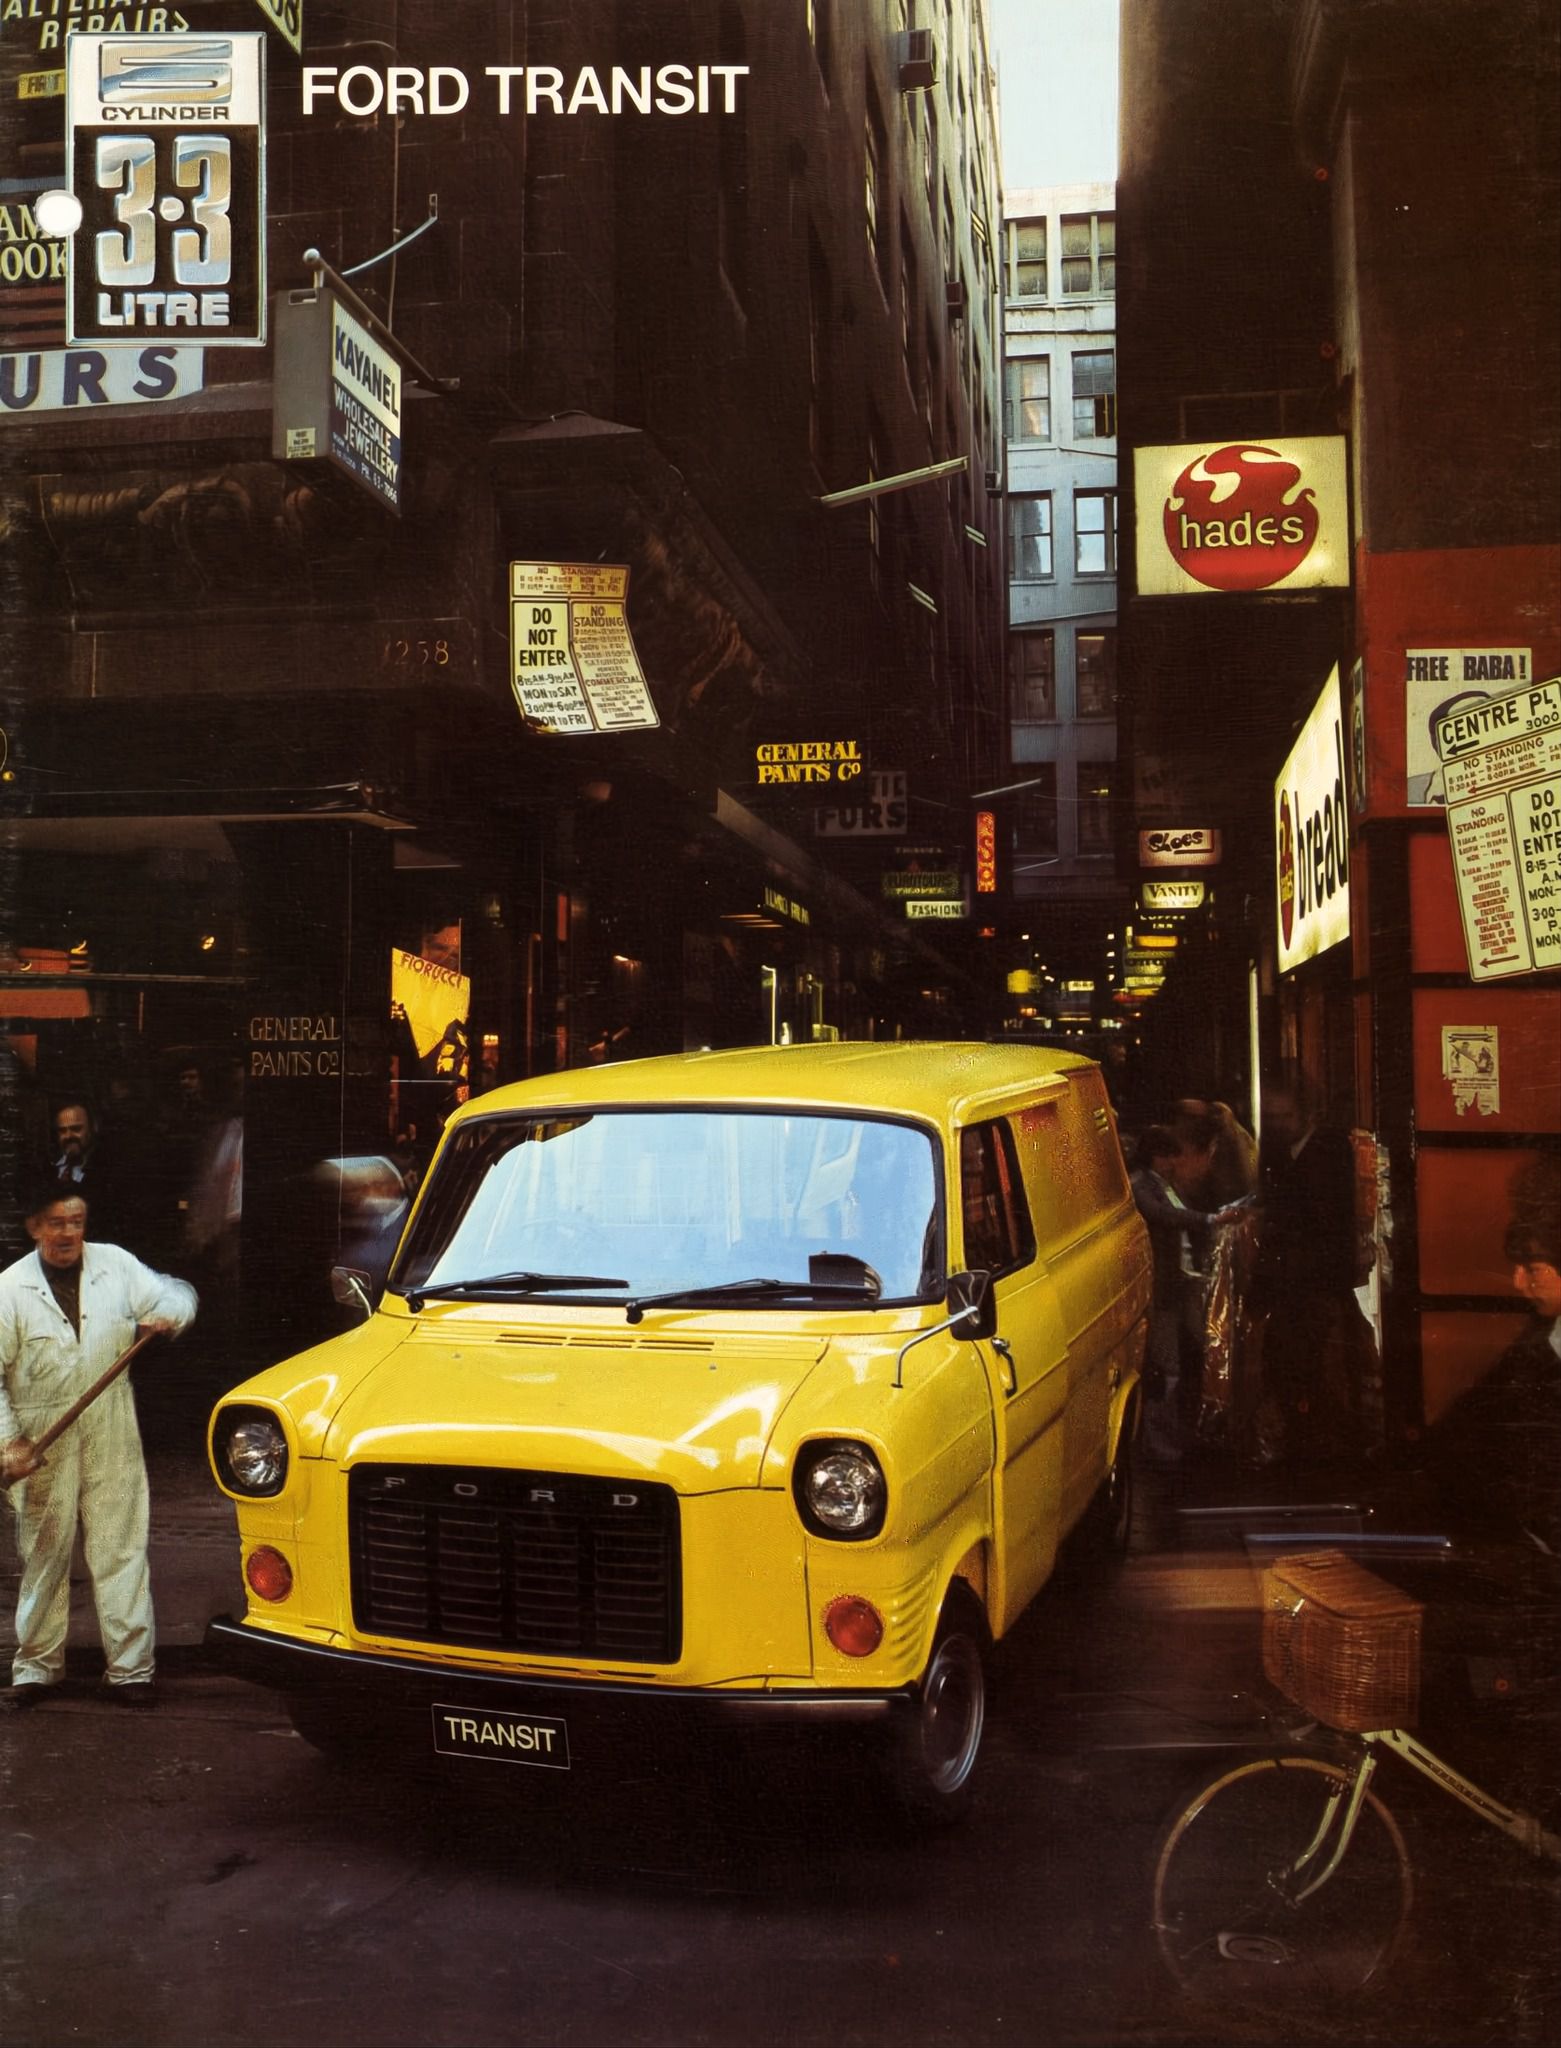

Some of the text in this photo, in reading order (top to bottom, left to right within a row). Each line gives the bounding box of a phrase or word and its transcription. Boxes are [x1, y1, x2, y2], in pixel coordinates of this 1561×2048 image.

[335, 324, 399, 418] KAYANEL
[334, 383, 392, 455] WHOLESALE
[344, 419, 399, 484] JEWELLERY
[1180, 511, 1304, 549] hades
[532, 607, 552, 625] DO
[573, 616, 625, 628] STANDING
[590, 606, 606, 616] NO
[528, 629, 557, 645] NOT
[519, 649, 567, 667] ENTER
[1407, 656, 1449, 681] FREE
[523, 688, 548, 700] MON
[557, 686, 577, 698] SAT
[568, 714, 588, 725] FRI
[1442, 689, 1558, 745] CENTRE PL.
[1526, 711, 1560, 730] 3000
[757, 741, 861, 762] GENERAL
[1463, 737, 1544, 770] NO STANDING
[757, 763, 830, 784] PANTS
[1531, 789, 1554, 811] DO
[817, 803, 906, 830] FURS
[1294, 719, 1349, 921] bread
[1456, 813, 1505, 834] STANDING
[1471, 806, 1486, 818] NO
[1530, 809, 1561, 833] NOT
[1148, 831, 1204, 852] Shoes
[1149, 884, 1200, 898] VANITY
[400, 953, 462, 990] FIORUCCI
[249, 1016, 341, 1041] GENERAL
[251, 1052, 312, 1077] PANTS
[384, 1477, 637, 1507] FORD
[444, 1716, 556, 1752] TRANSIT
